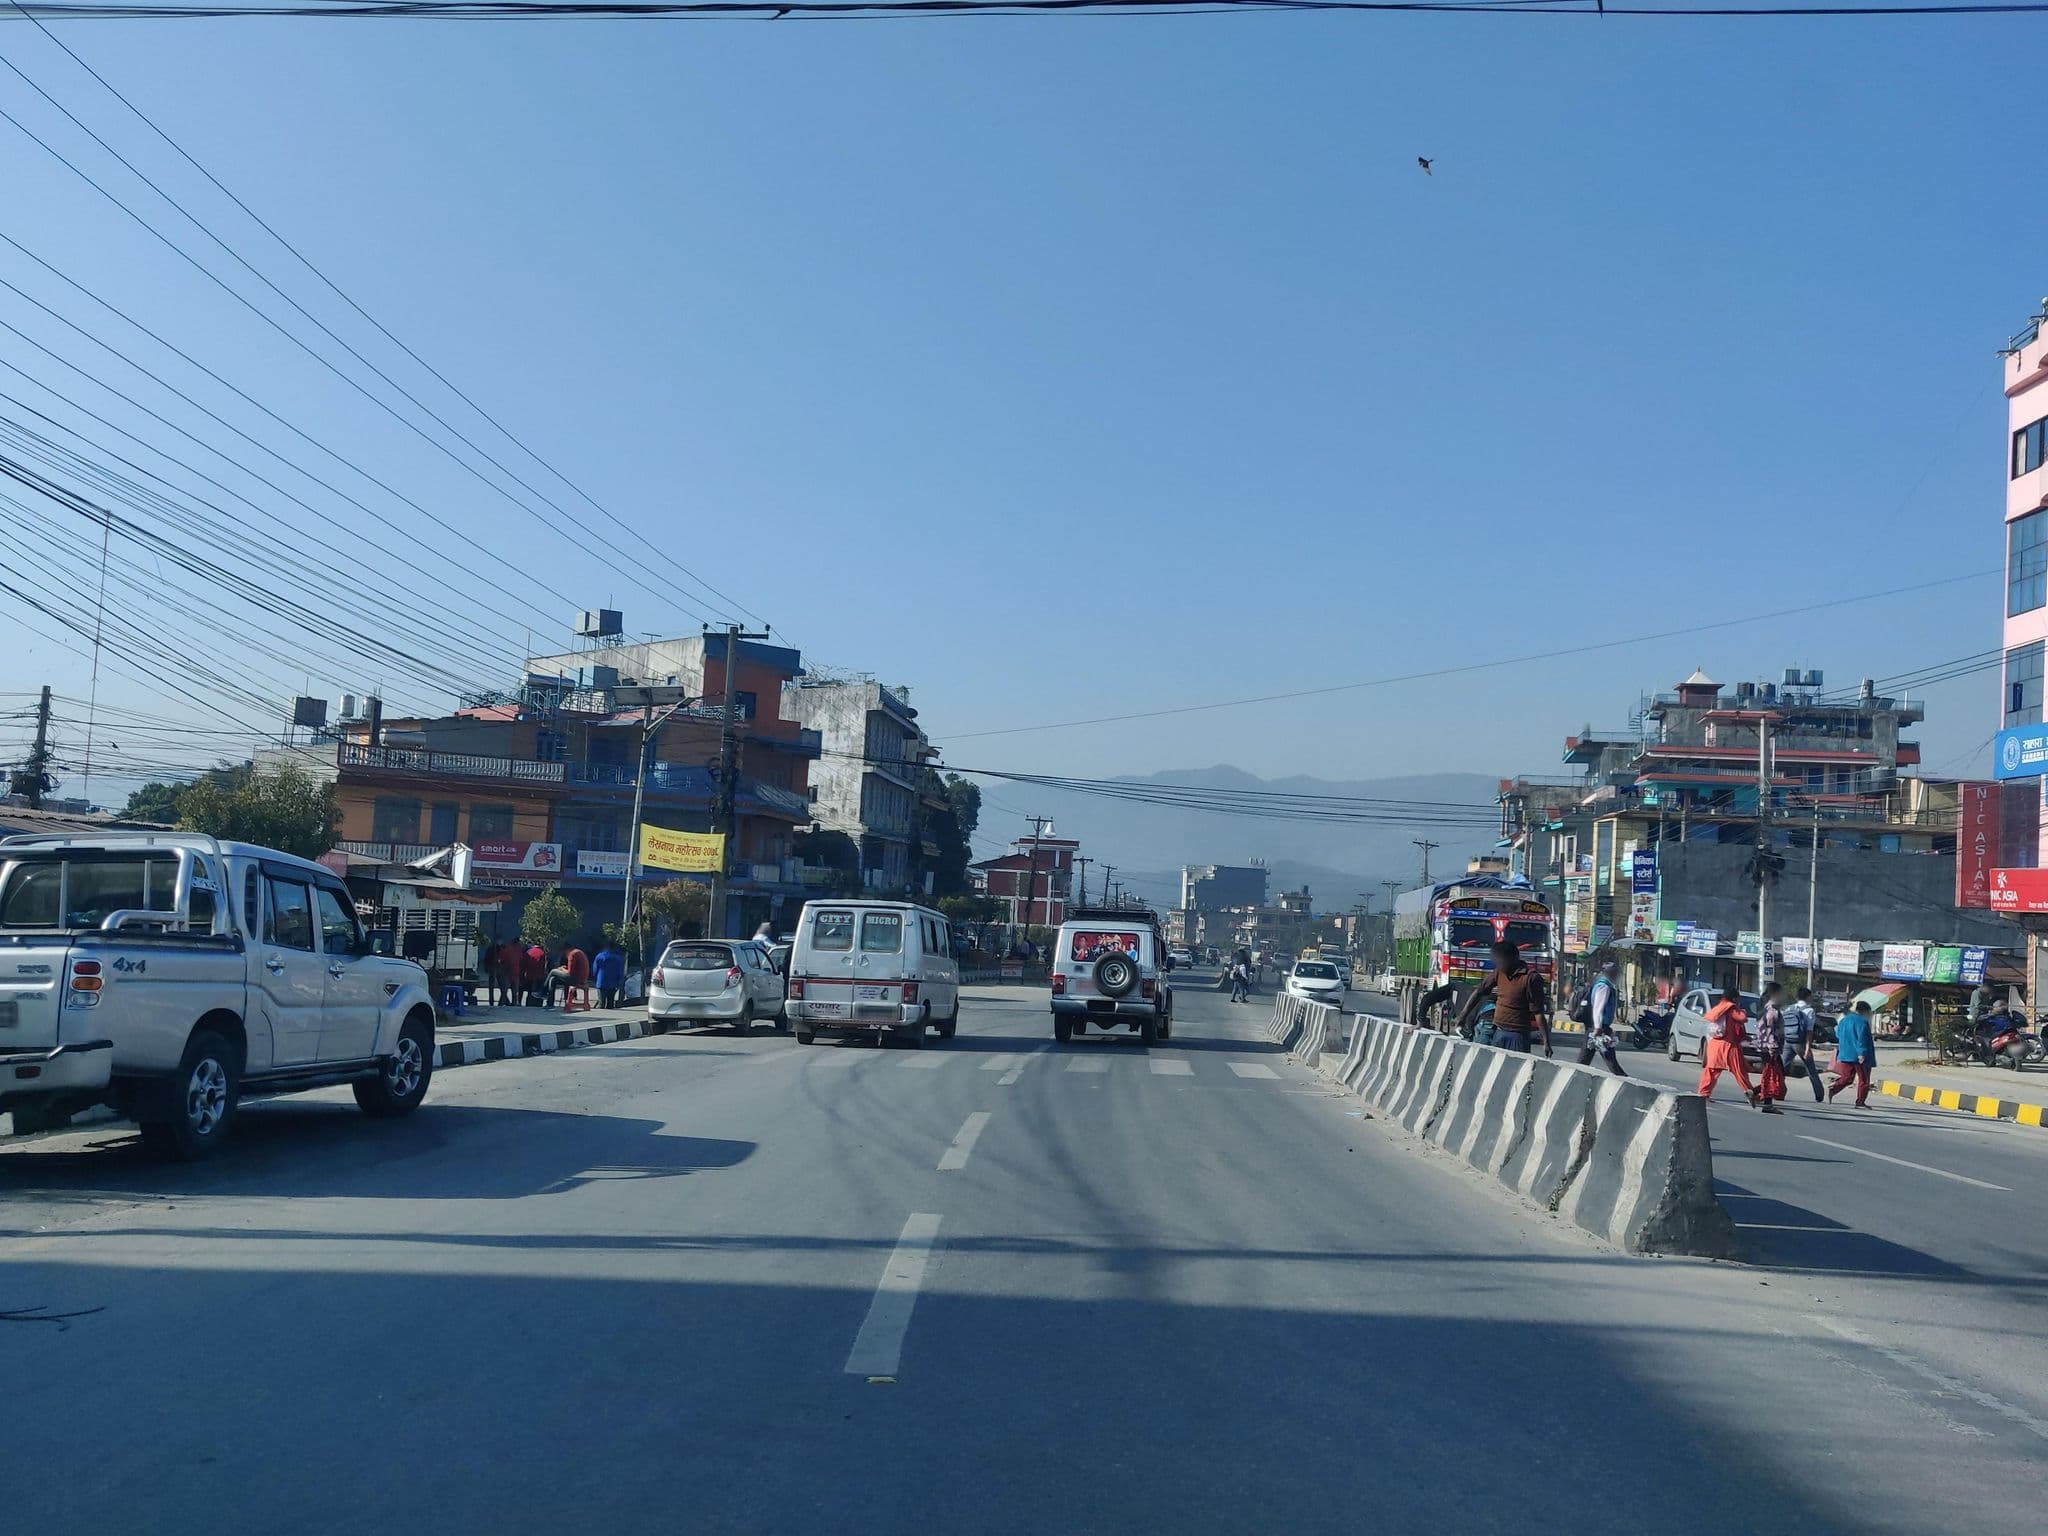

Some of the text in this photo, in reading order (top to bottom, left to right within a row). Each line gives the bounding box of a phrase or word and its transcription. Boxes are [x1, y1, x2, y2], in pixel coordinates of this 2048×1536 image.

[1973, 787, 1988, 881] NIC ASIA
[480, 845, 505, 853] smart
[647, 835, 675, 852] लेखनाथ
[675, 843, 702, 856] महोत्सव
[478, 879, 502, 887] DIGITAL
[504, 879, 529, 887] PHOTO
[1990, 890, 2019, 902] NIC ASIA
[820, 915, 899, 925] CITY MICRO
[112, 957, 147, 974] 4x4
